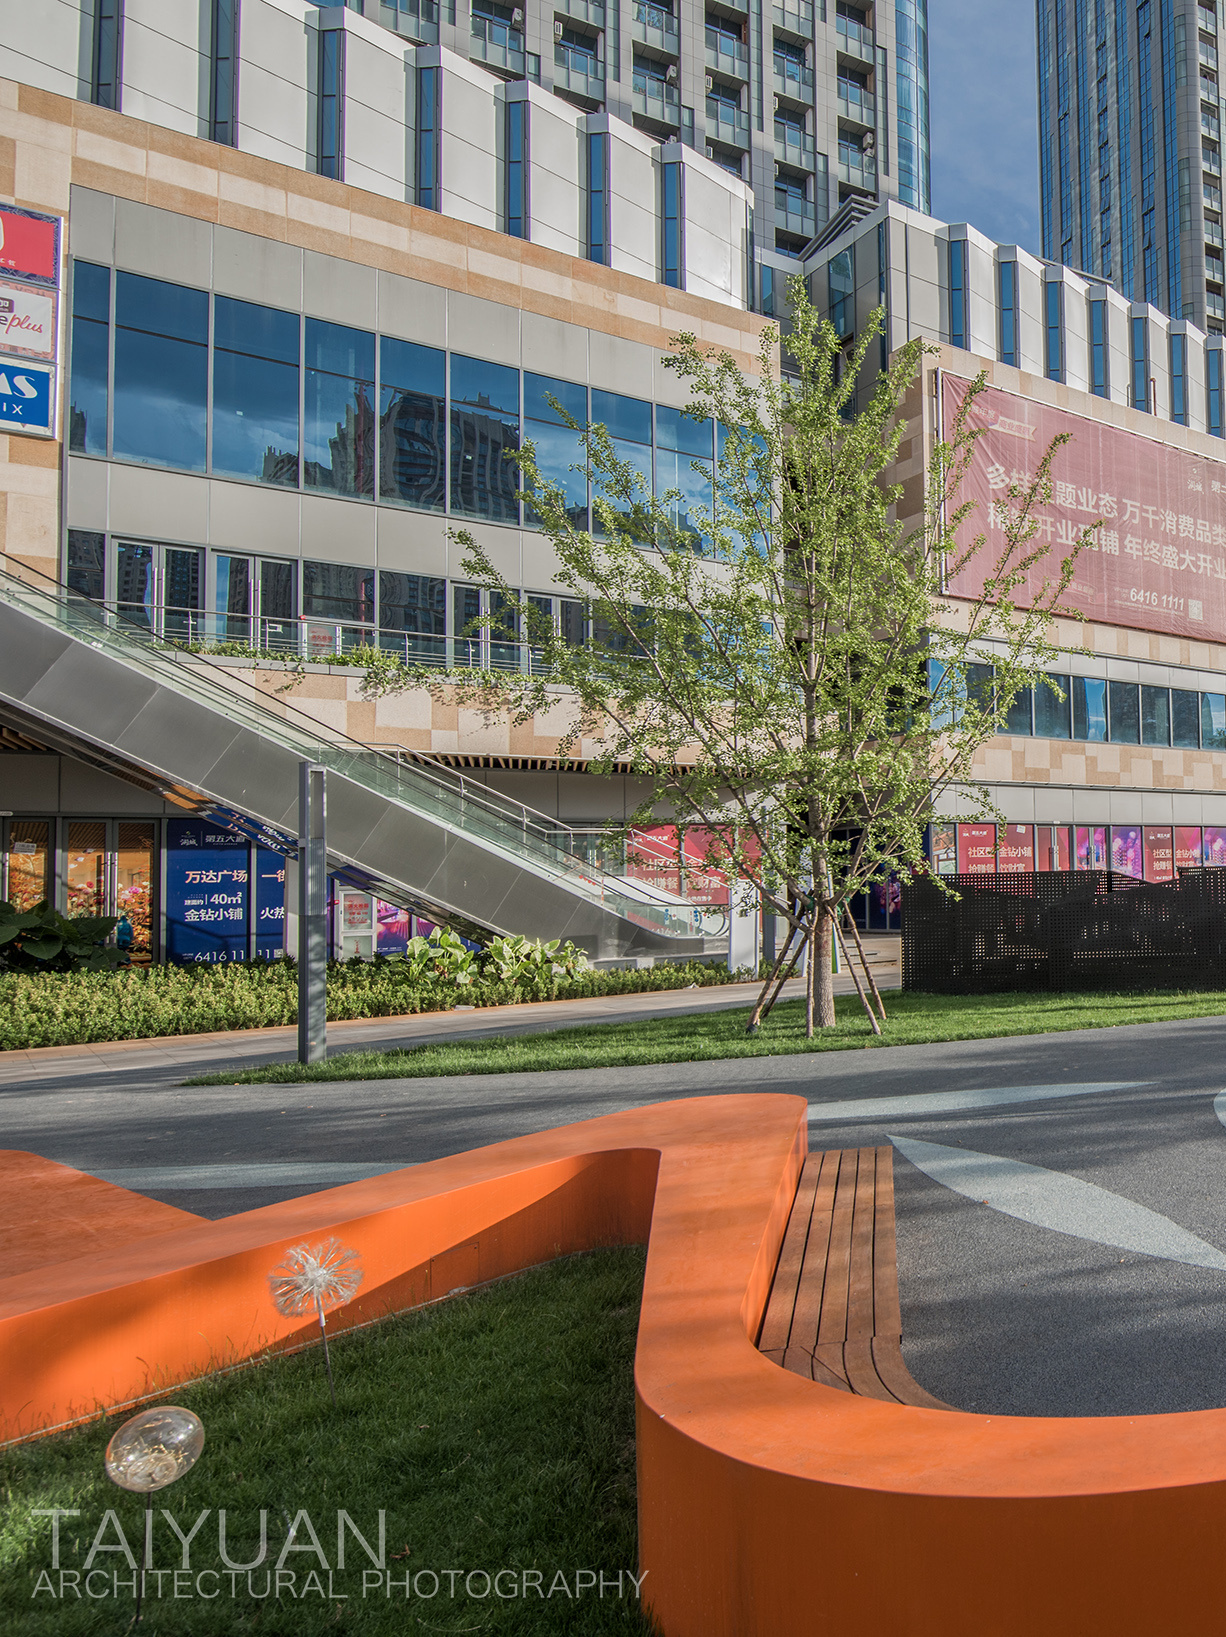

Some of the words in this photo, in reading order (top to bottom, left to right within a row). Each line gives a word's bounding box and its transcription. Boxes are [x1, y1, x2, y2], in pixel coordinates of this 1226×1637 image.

[1130, 587, 1159, 606] 6416
[1161, 594, 1185, 611] 1111
[185, 869, 248, 884] 万达广场
[184, 907, 243, 922] 金钻小铺
[194, 951, 228, 962] 6416
